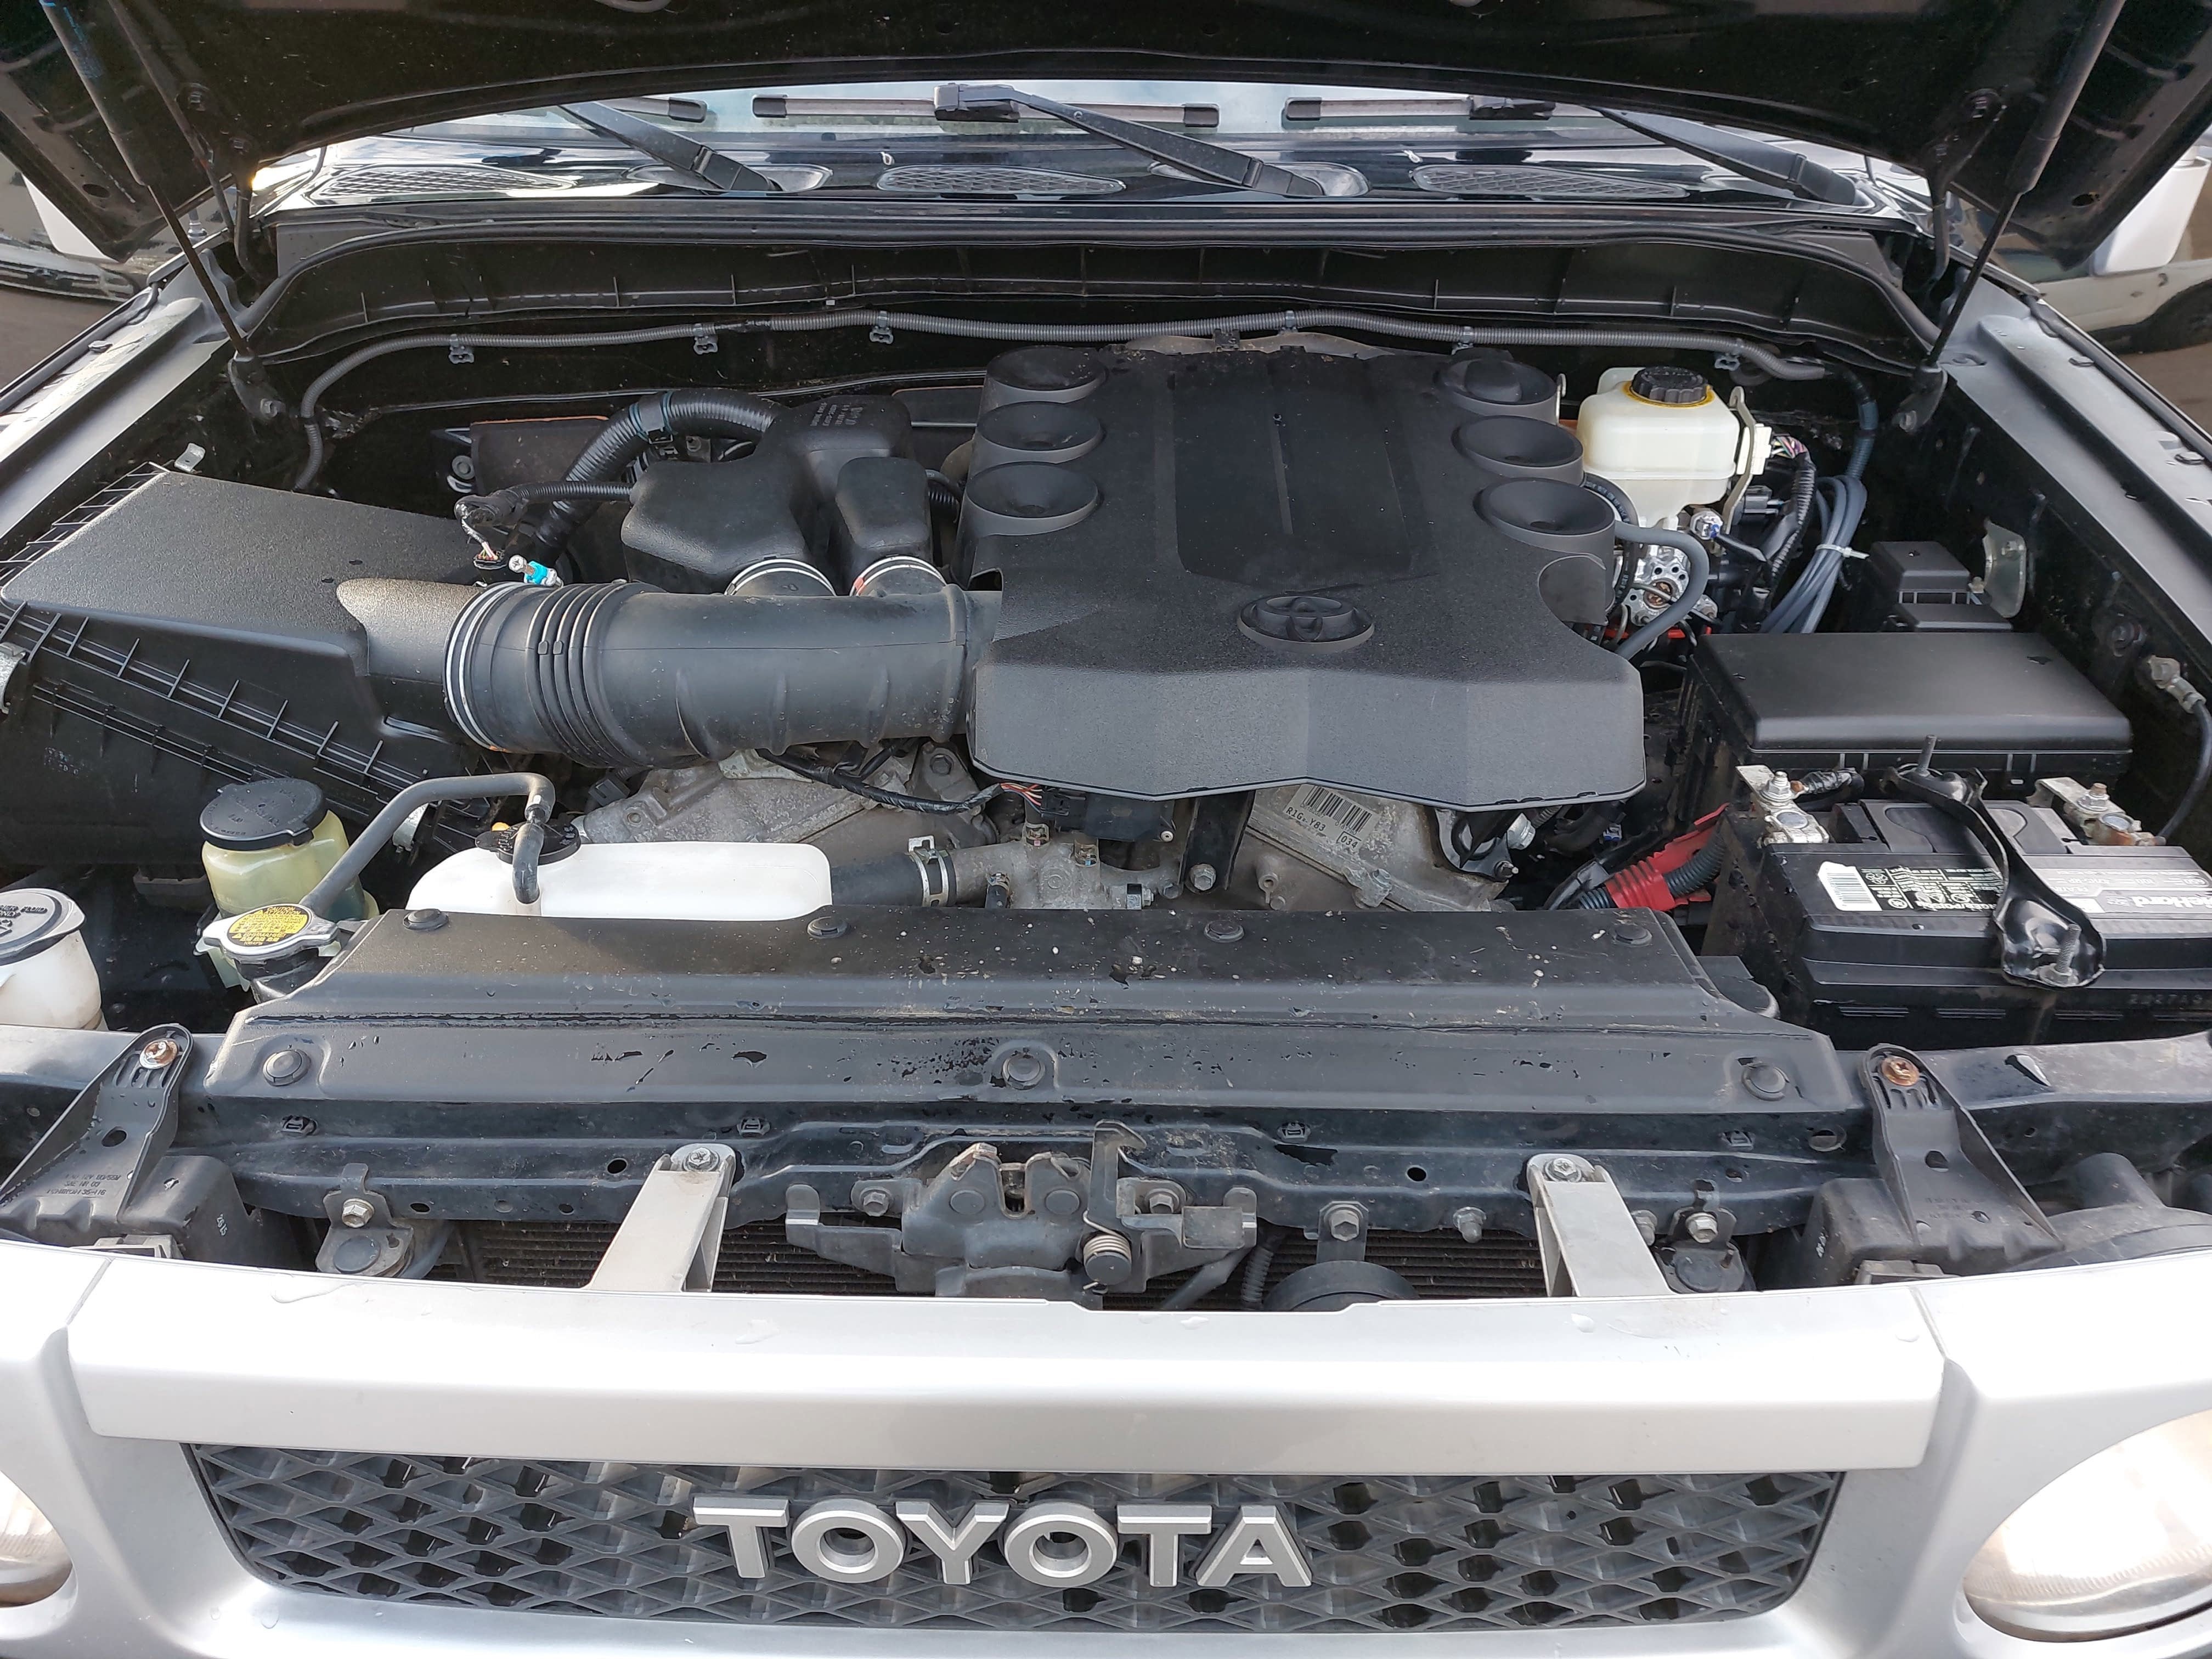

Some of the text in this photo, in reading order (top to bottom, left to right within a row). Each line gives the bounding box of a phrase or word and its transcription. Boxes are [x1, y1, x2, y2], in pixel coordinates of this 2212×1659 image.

[1341, 836, 1358, 849] 034
[2129, 895, 2212, 909] ieHard
[693, 1497, 1312, 1587] TOYOTA
